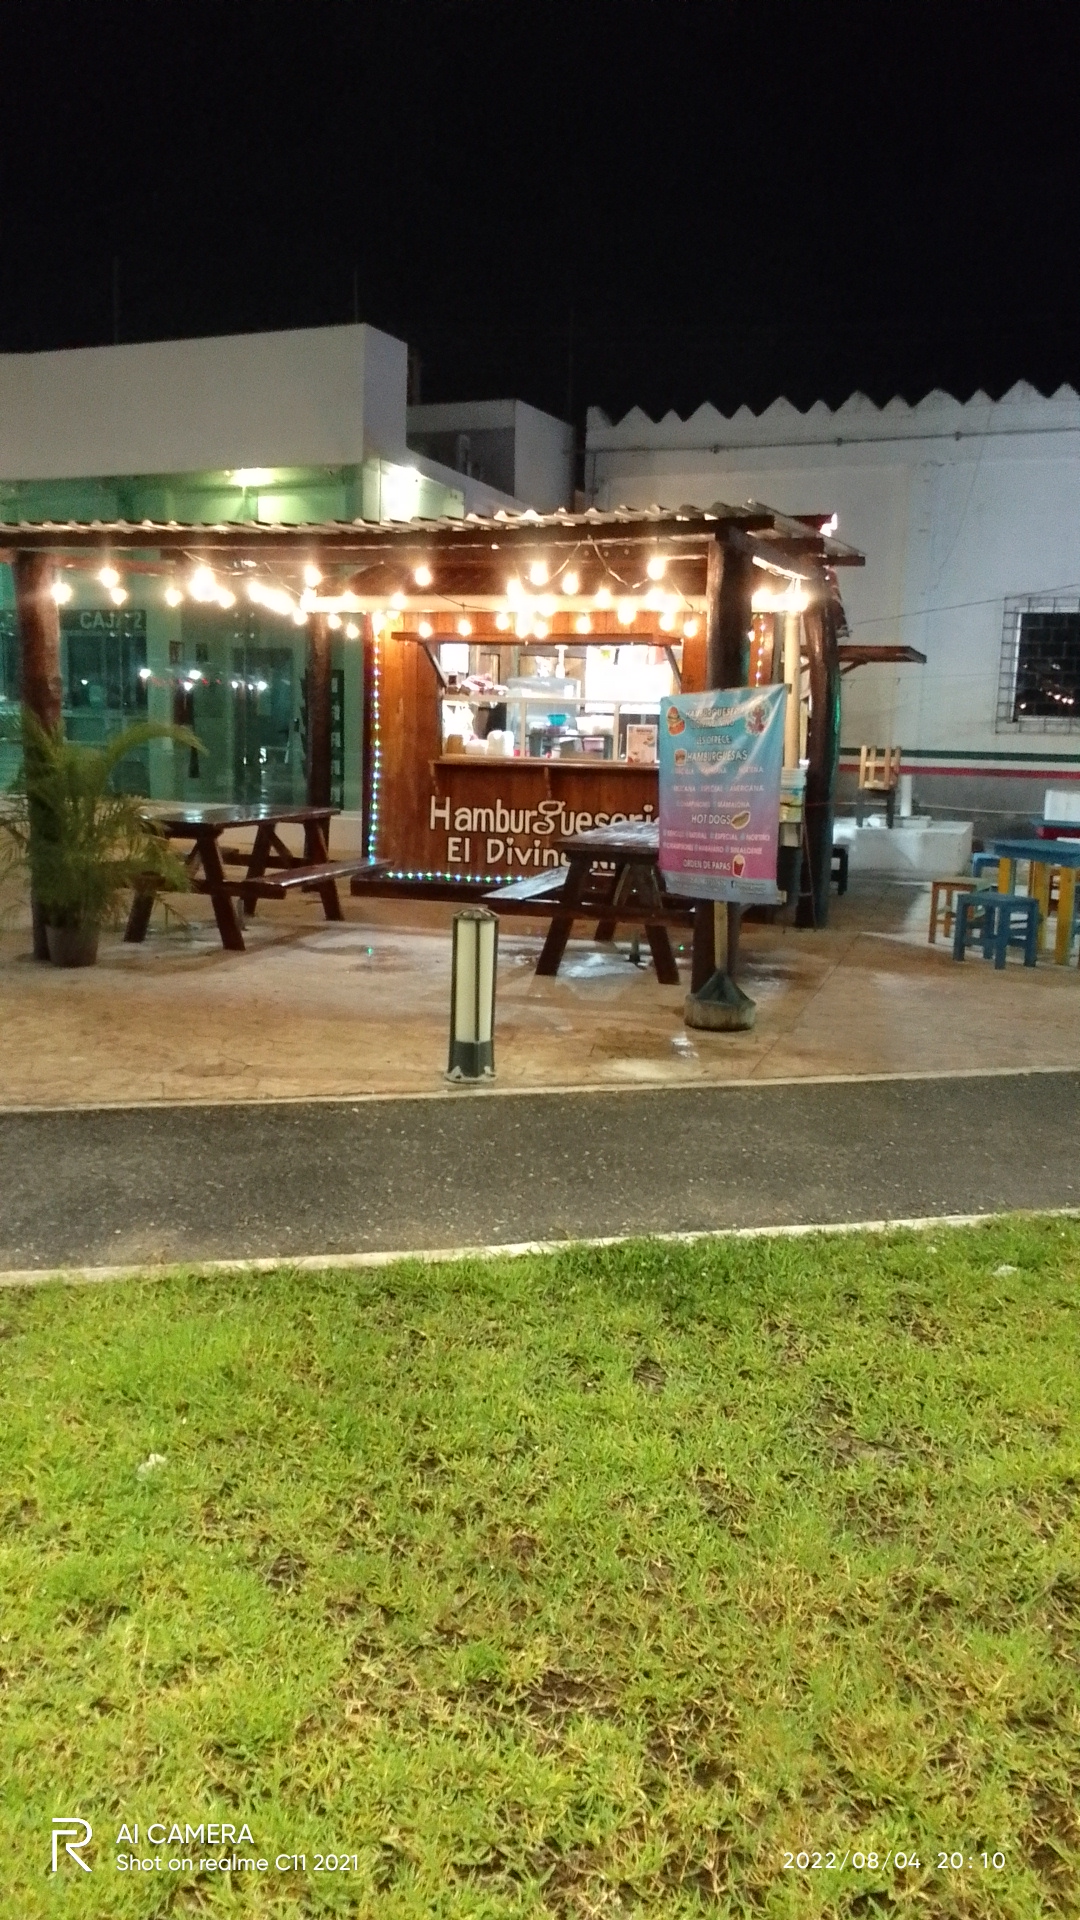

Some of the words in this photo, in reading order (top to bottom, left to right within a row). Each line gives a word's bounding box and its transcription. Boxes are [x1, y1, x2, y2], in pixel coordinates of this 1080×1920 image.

[687, 750, 748, 762] HAMBURGUESAS
[430, 795, 660, 836] Hamburguesri
[691, 814, 707, 825] HOT
[708, 814, 731, 825] DOGS
[447, 836, 470, 863] El
[486, 837, 572, 867] Divin
[703, 861, 711, 870] DE
[712, 862, 731, 871] PAPAS
